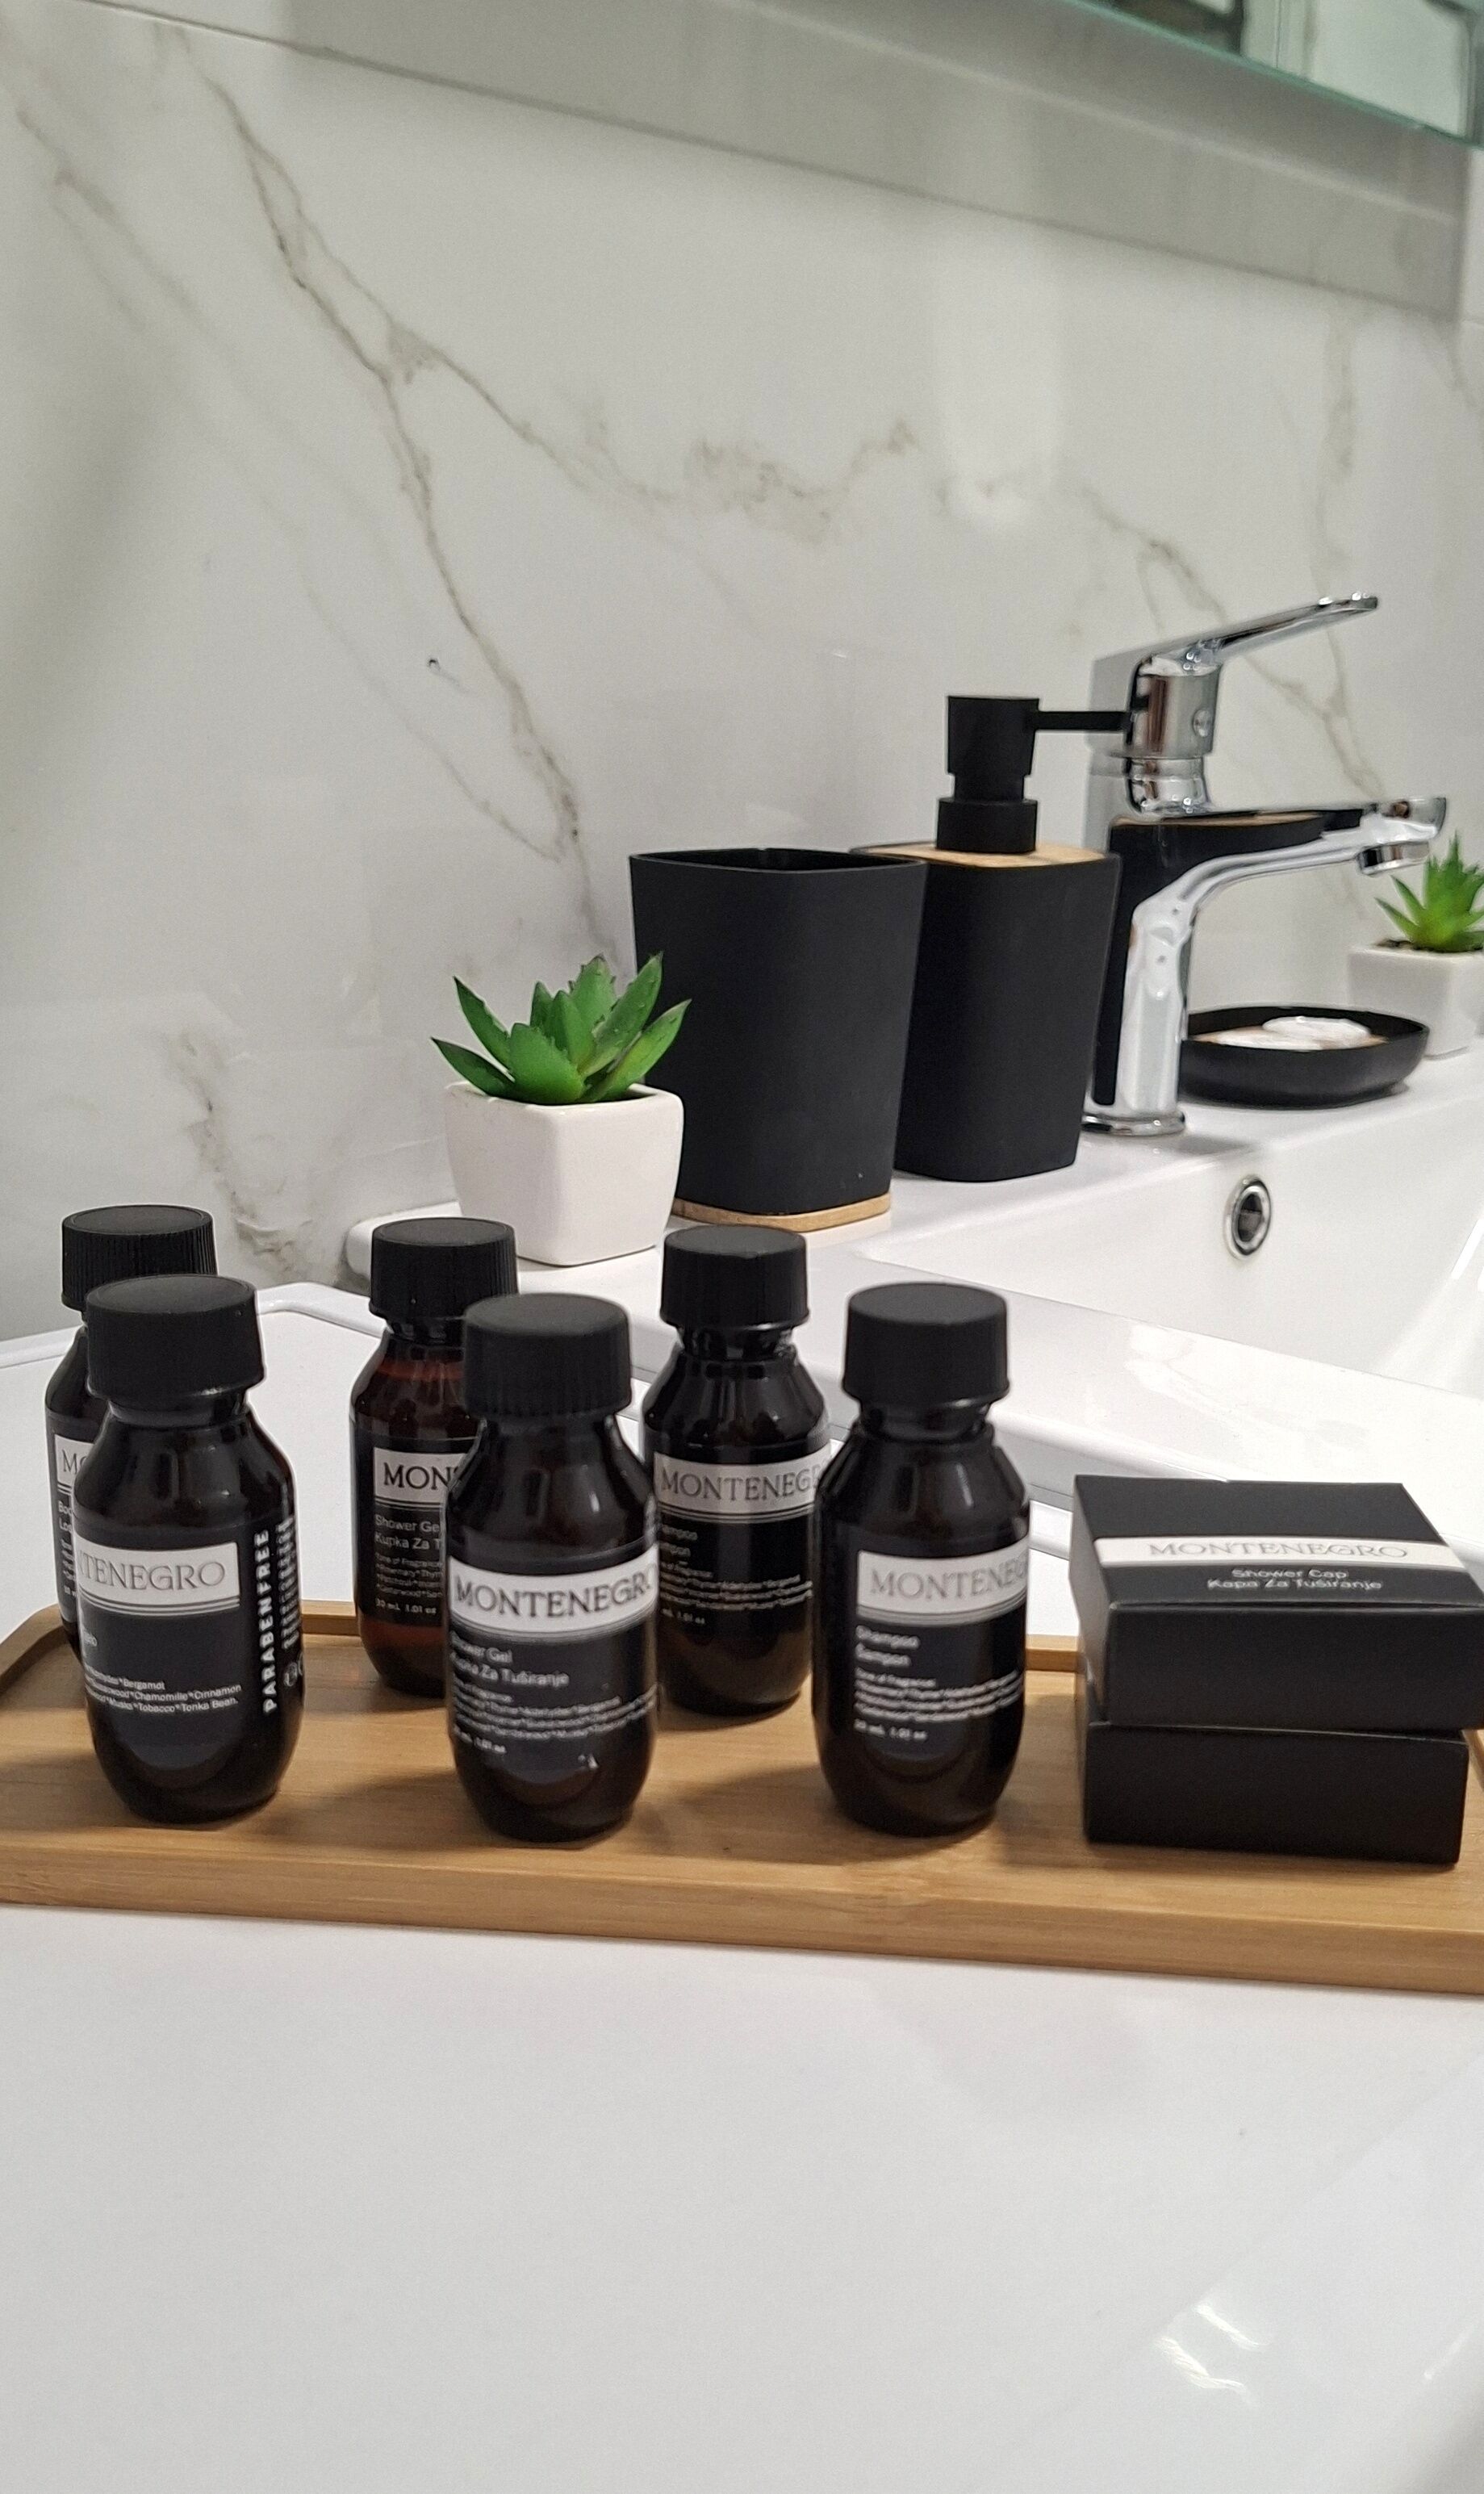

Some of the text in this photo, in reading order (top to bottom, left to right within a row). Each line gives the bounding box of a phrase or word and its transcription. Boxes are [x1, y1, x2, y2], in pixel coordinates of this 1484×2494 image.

[374, 1513, 441, 1533] Shower Ge
[412, 1538, 430, 1550] Za
[1148, 1542, 1408, 1558] MONTENEGRO
[1231, 1568, 1348, 1580] Shower Cap
[1207, 1578, 1259, 1590] Kapa
[1264, 1578, 1289, 1589] Za
[254, 1529, 278, 1714] PARABENFREE
[123, 1678, 165, 1691] Bergamot
[194, 1684, 241, 1701] Cinnamon
[138, 1703, 175, 1714] Tobacco
[180, 1702, 210, 1713] Tonka
